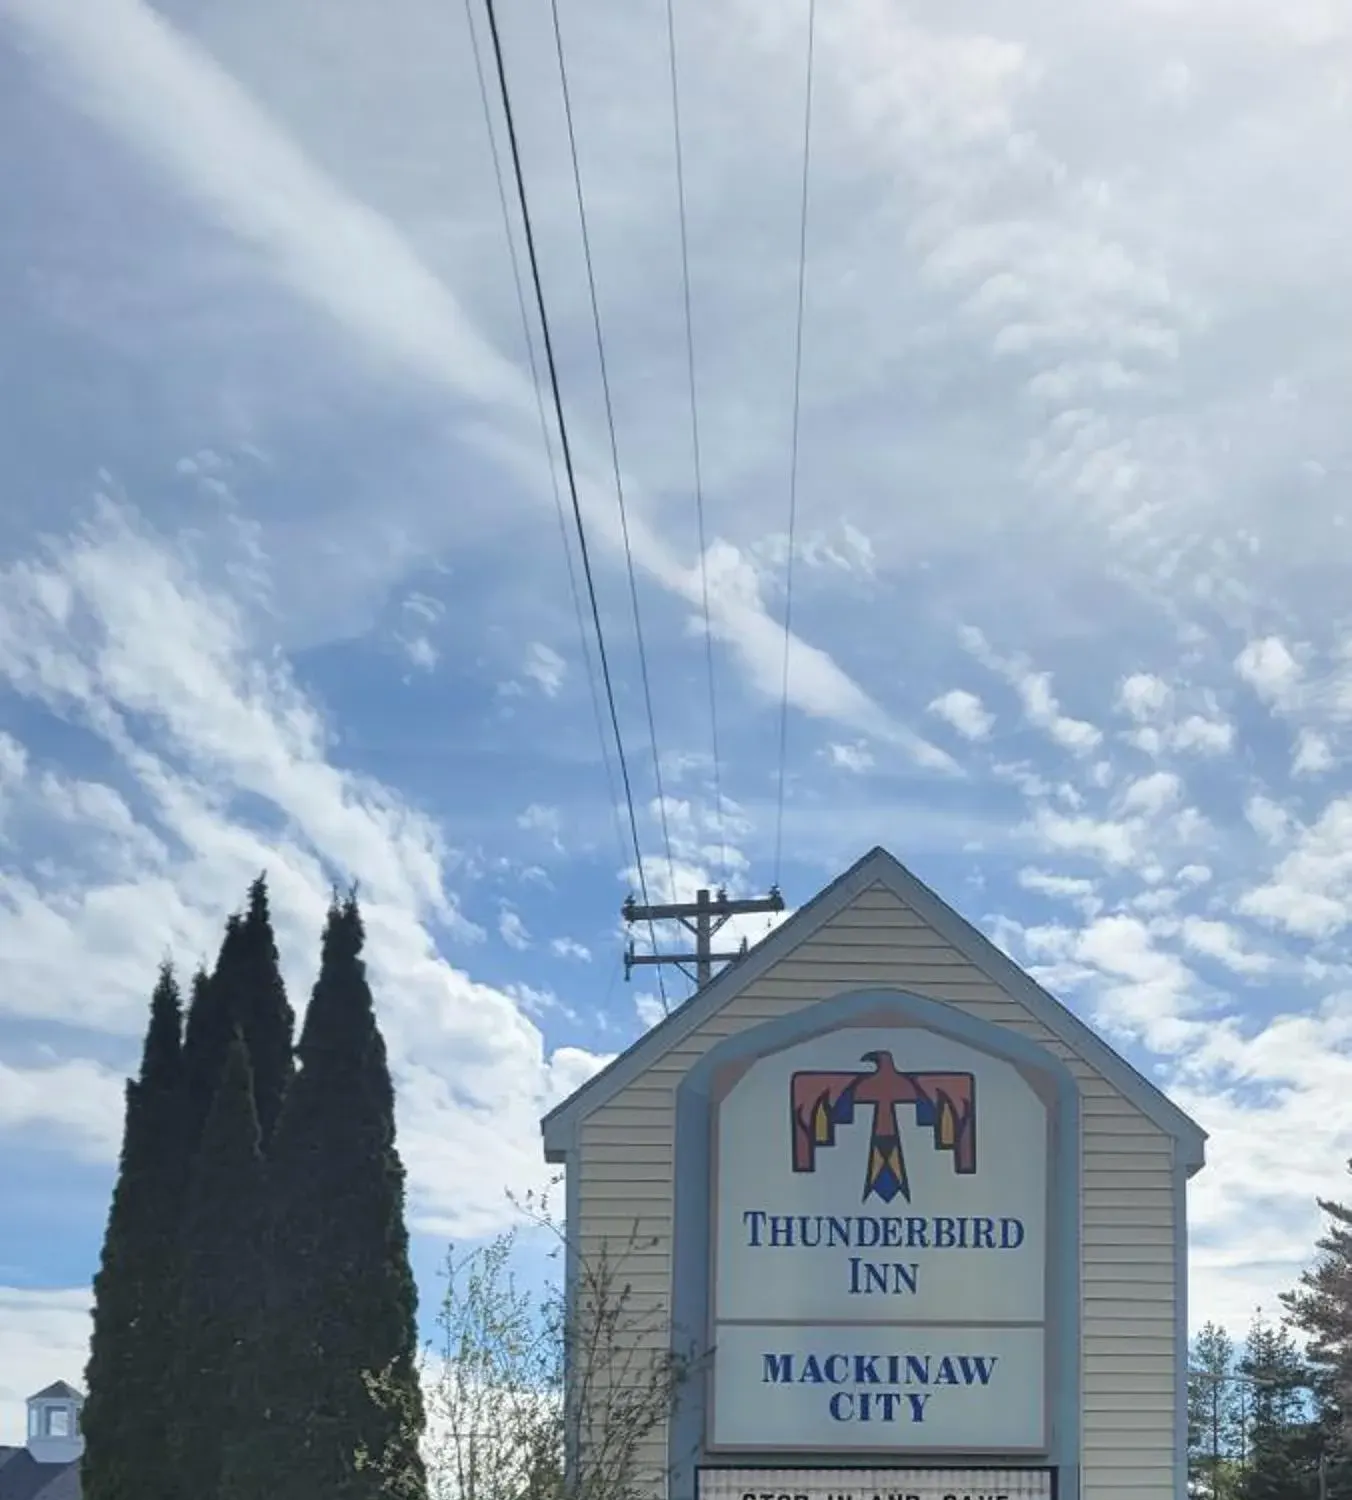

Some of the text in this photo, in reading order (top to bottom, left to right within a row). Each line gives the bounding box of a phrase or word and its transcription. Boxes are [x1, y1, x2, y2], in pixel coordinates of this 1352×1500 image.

[743, 1211, 1025, 1249] THUNDERBIRD
[847, 1257, 920, 1294] INN
[762, 1353, 998, 1385] MACKINAW
[829, 1392, 931, 1422] CITY
